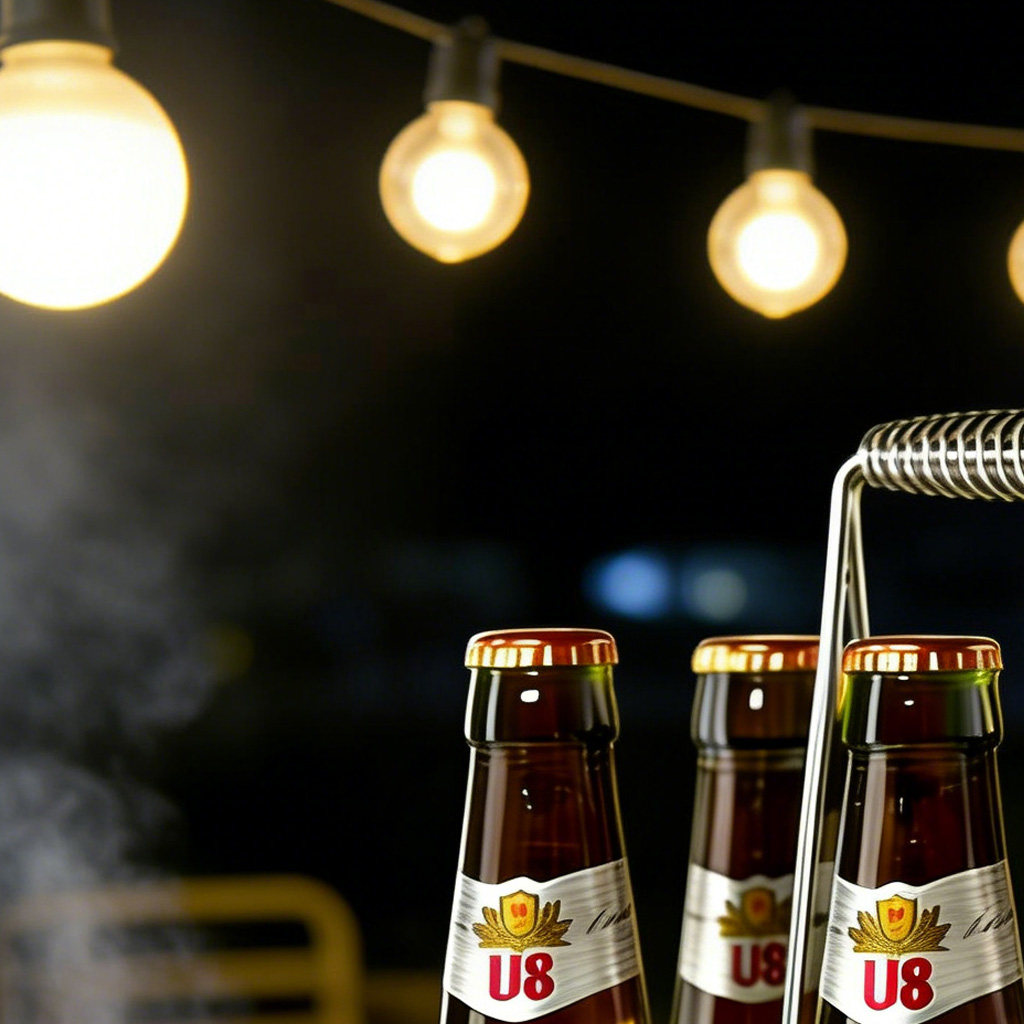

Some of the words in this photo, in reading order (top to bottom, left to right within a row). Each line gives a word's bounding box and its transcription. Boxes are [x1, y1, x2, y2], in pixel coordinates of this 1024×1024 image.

[488, 952, 555, 1001] U8
[731, 942, 787, 987] U8
[863, 957, 935, 1010] U8
